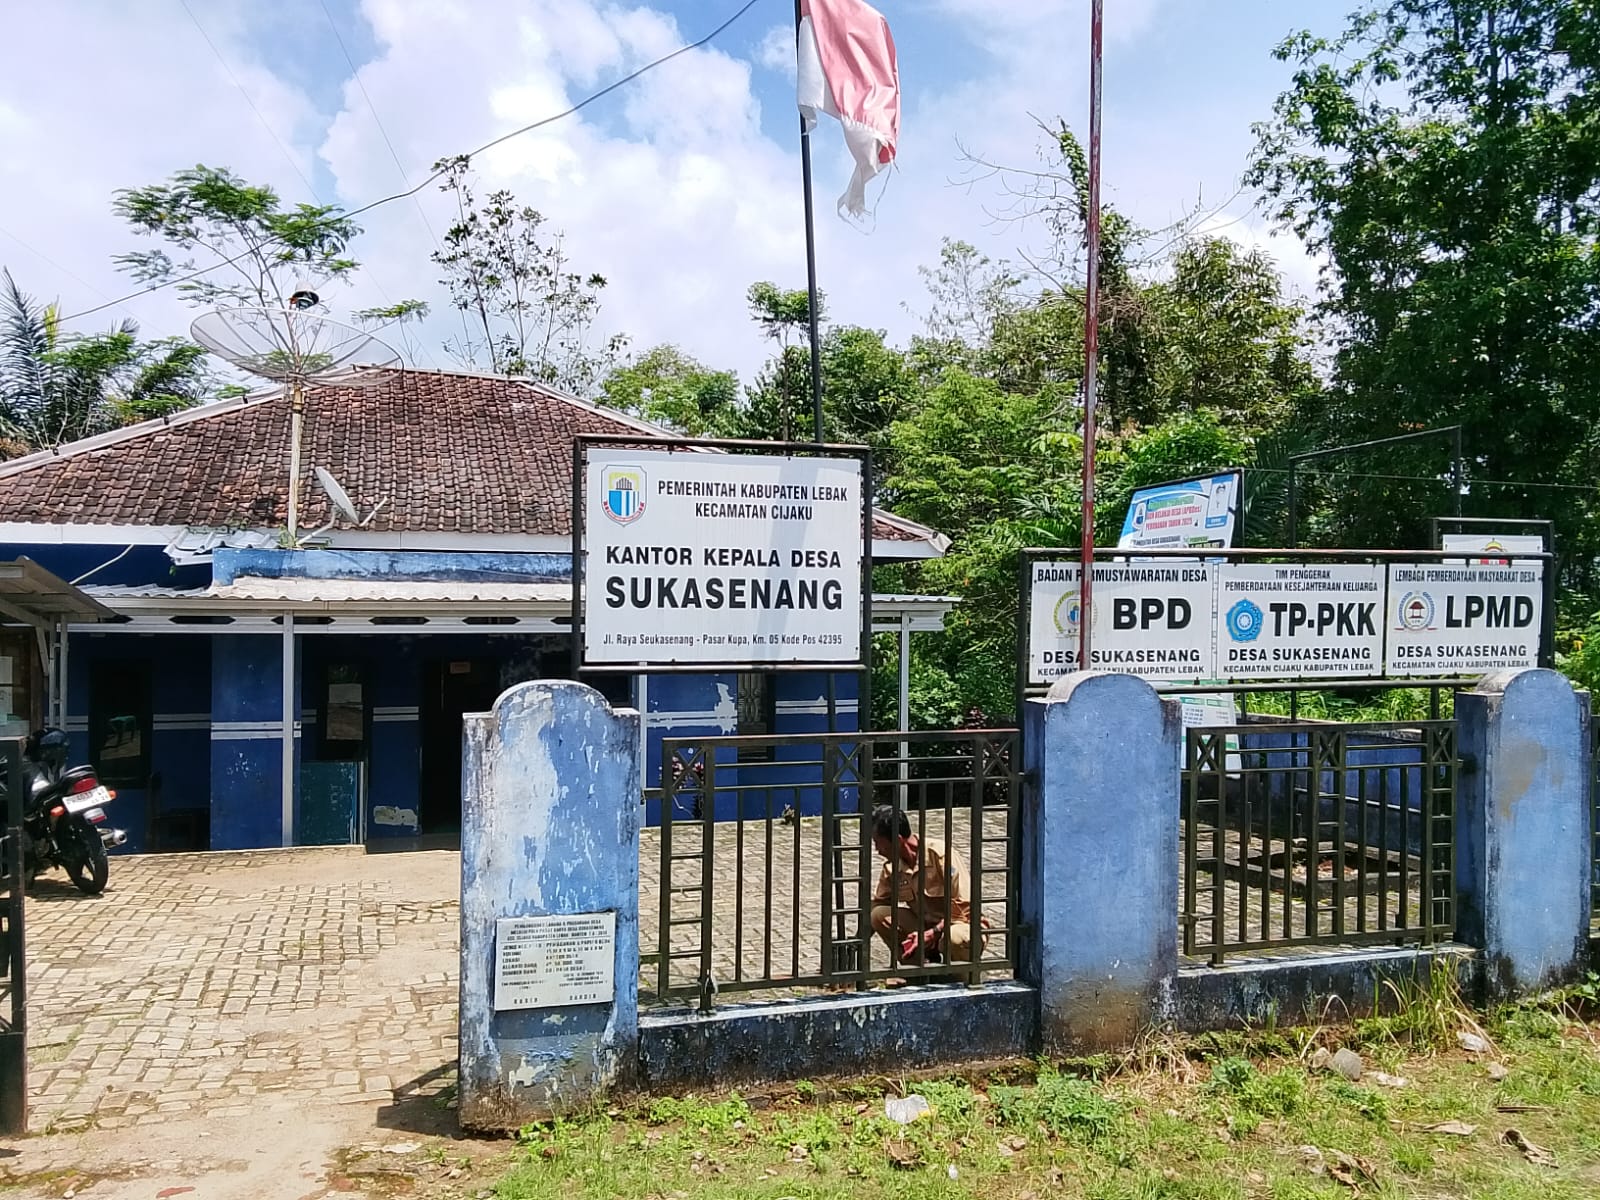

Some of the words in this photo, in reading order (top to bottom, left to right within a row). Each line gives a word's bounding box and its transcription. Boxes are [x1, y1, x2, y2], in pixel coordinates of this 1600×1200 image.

[658, 480, 736, 498] PEMERINTAH
[741, 483, 808, 500] KABUPATEN
[812, 486, 848, 501] LEBAK
[695, 503, 767, 519] KECAMATAN
[771, 505, 813, 520] CIJAKU
[606, 546, 693, 566] KANTOR
[704, 548, 780, 567] KEPALA
[791, 550, 841, 568] DESA
[1037, 569, 1072, 582] BADAN
[1076, 569, 1179, 583] PRMUSYAWARATAN
[1182, 569, 1208, 582] DESA
[1275, 569, 1288, 580] TIM
[1290, 569, 1332, 580] PENGGERAK
[1395, 570, 1425, 582] LEMBAGA
[1426, 570, 1477, 582] PEMBERDAYAAN
[1478, 571, 1519, 582] MASYARAKAT
[1519, 571, 1536, 583] DESA
[605, 576, 842, 610] SUKASENANG
[1225, 581, 1283, 592] PEMBERDAYAAN
[1284, 581, 1341, 592] KESEJAHTERAAN
[1342, 581, 1378, 592] KELUARGA
[1113, 598, 1192, 630] BPD
[1445, 595, 1534, 628] LPMD
[603, 634, 614, 645] Jl.
[616, 634, 637, 646] Raya
[639, 634, 694, 647] Seukasenang
[702, 634, 726, 645] Pasar
[728, 634, 750, 647] Kupa,
[752, 634, 767, 645] Km.
[769, 635, 779, 645] 05
[781, 634, 800, 645] Kode
[802, 634, 816, 645] Pos
[818, 634, 842, 645] 42395
[1091, 649, 1200, 663] SUKASENANG
[1229, 648, 1268, 661] DESA
[1272, 647, 1371, 660] SUKASENANG
[1397, 646, 1433, 658] DESA
[1436, 645, 1527, 657] SUKASENANG
[1126, 666, 1175, 674] KABUPATEN
[1178, 665, 1205, 674] LEBAK
[1223, 664, 1271, 673] KECAMATAN
[1273, 664, 1301, 672] CIJAKU
[1303, 663, 1348, 672] KABUPATEN
[1350, 663, 1374, 671] LEBAK
[1392, 661, 1436, 669] KECAMATAN
[1437, 661, 1464, 669] CIJAKU
[1507, 660, 1530, 668] LEBAK
